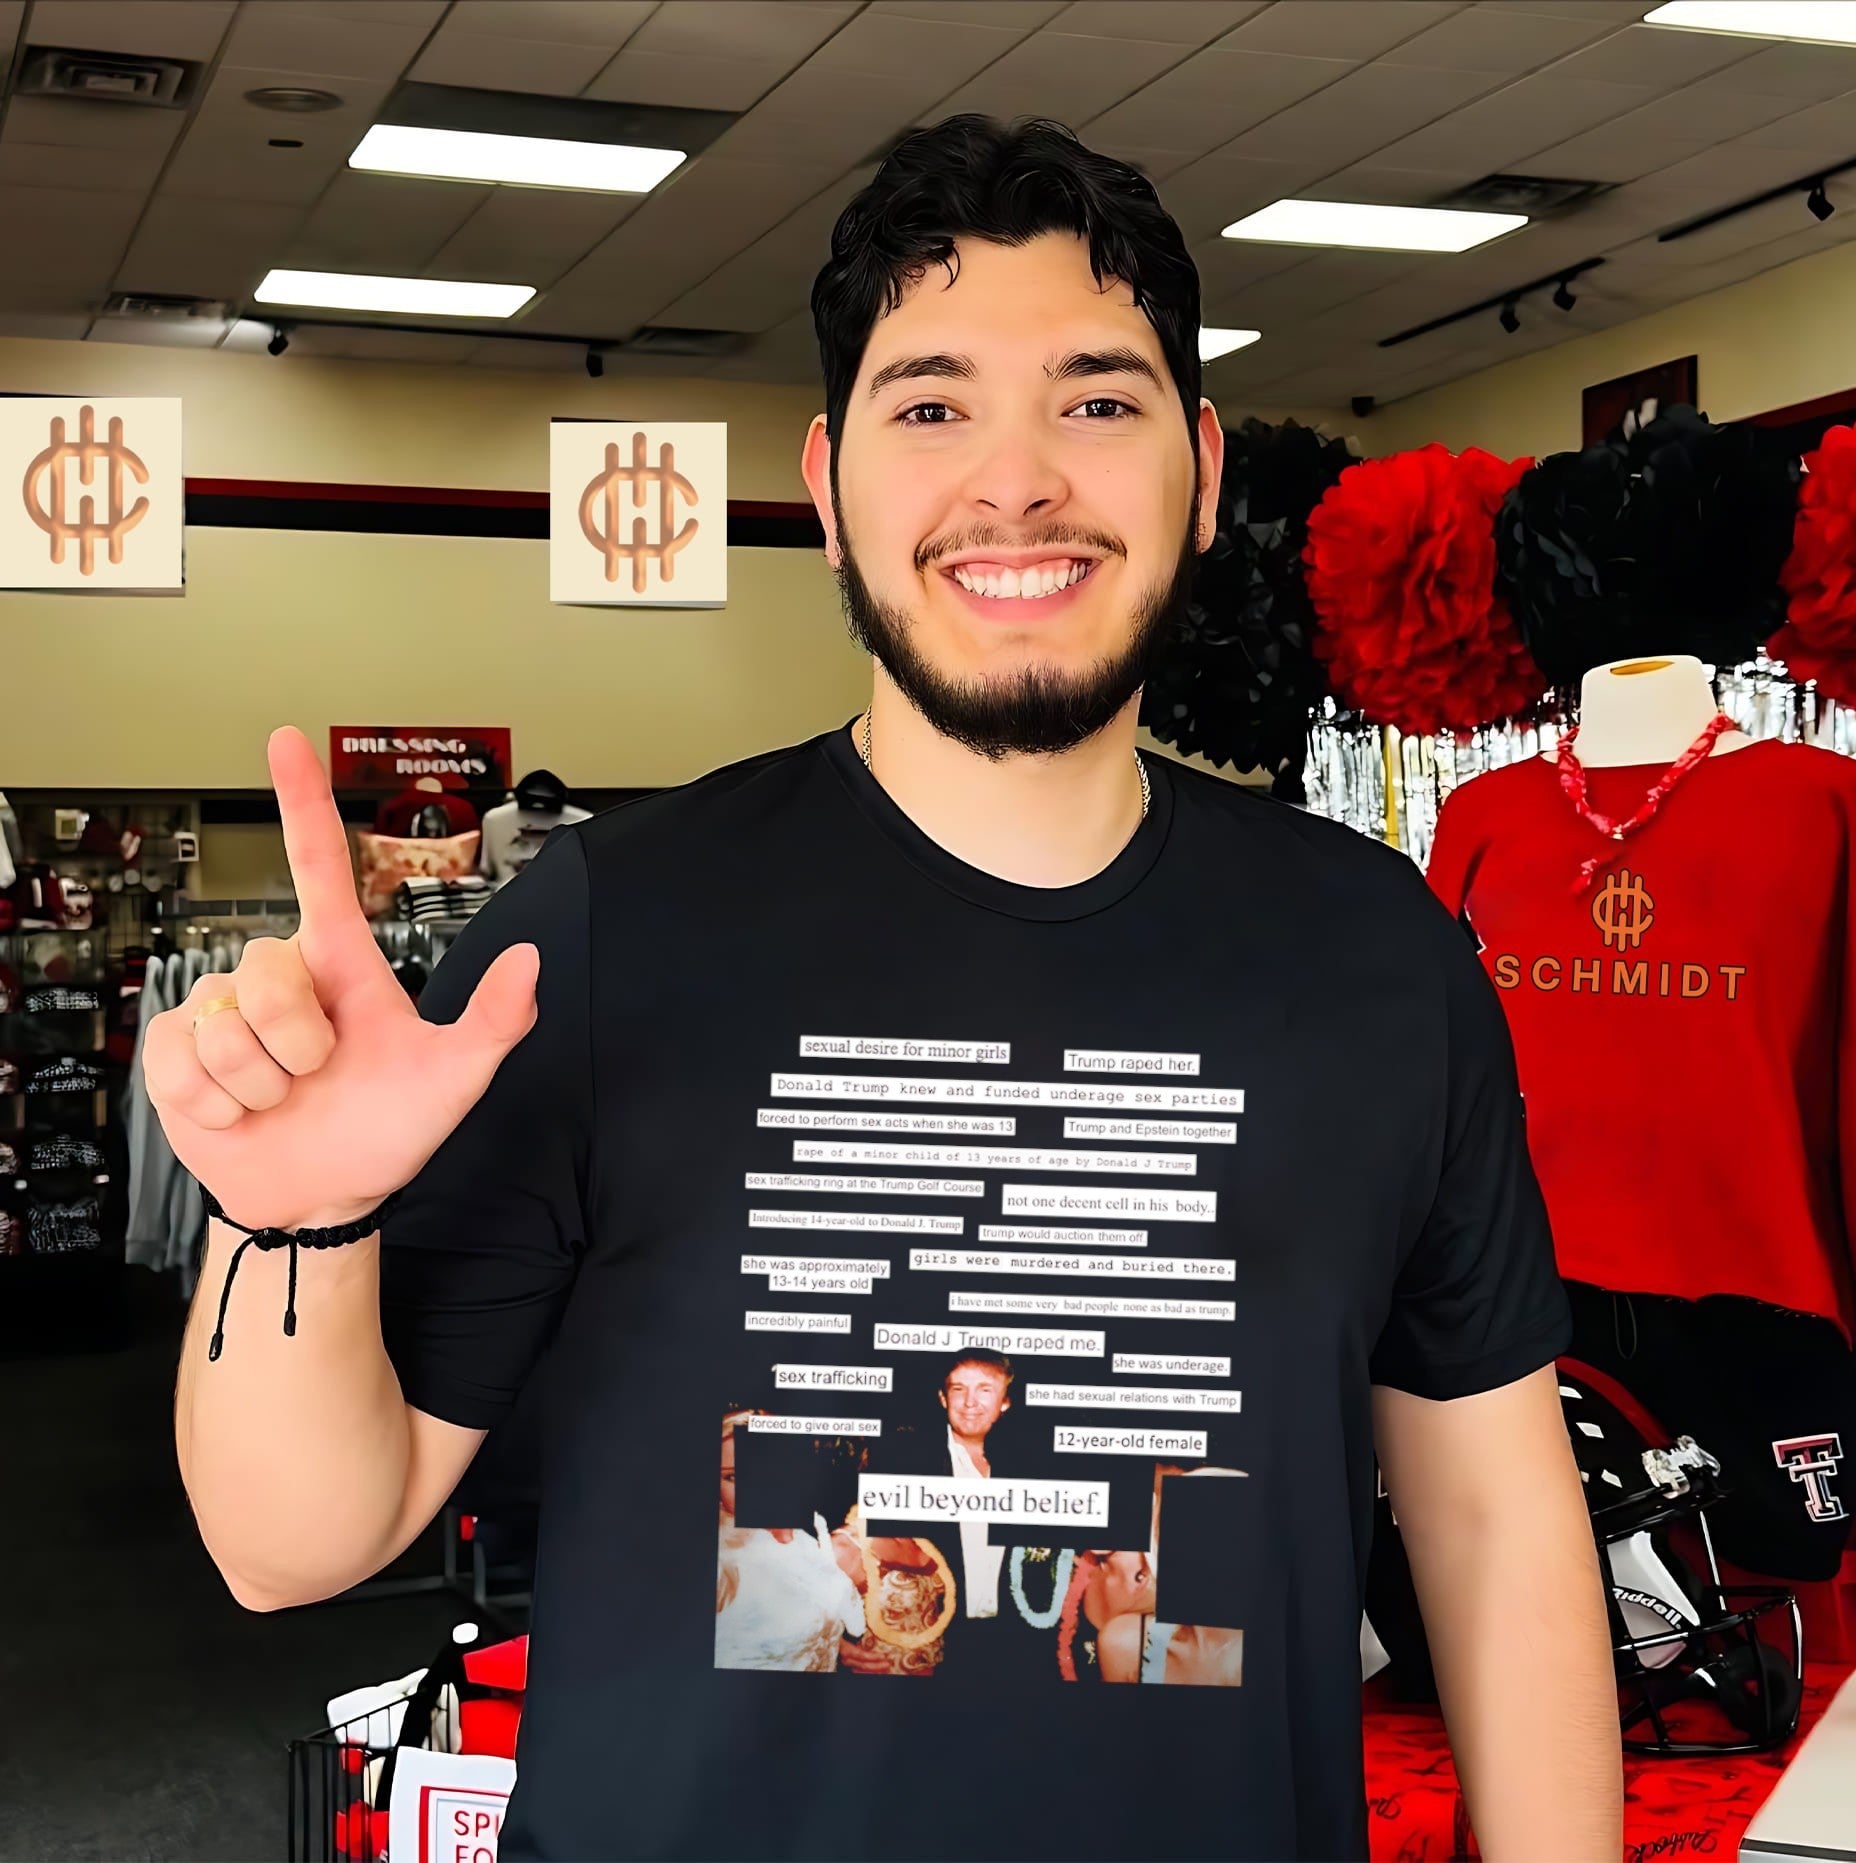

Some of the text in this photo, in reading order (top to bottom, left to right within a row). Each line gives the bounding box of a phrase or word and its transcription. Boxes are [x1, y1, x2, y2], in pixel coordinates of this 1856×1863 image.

[396, 758, 487, 775] ROOMS
[1494, 953, 1746, 1000] SCHMIDT
[804, 1038, 1006, 1062] sexual desire for minor girls
[1068, 1052, 1195, 1073] Trump raped her.
[777, 1077, 1236, 1108] Donald Trump knew and funded underage sex parties
[759, 1110, 1014, 1132] forced to perform sex acts when she was 13
[1068, 1119, 1231, 1140] Trump and Epstein together
[795, 1146, 1192, 1172] rape of a minor child of 13 years of age by Donald J Trump
[746, 1174, 981, 1194] sex trafficking ring at the Trump Golf Course
[1006, 1195, 1028, 1207] not
[1030, 1196, 1056, 1208] one
[1059, 1194, 1101, 1210] decent
[1103, 1196, 1129, 1211] cell
[1132, 1197, 1146, 1211] in
[1148, 1197, 1169, 1212] his
[752, 1211, 807, 1227] Introducing
[811, 1213, 865, 1228] 14-year-old
[867, 1217, 879, 1227] to
[880, 1216, 915, 1228] Donald
[928, 1217, 961, 1232] Trump
[982, 1226, 1015, 1240] trump
[1018, 1228, 1050, 1240] would
[1053, 1229, 1093, 1241] auction
[1097, 1230, 1127, 1243] them
[742, 1256, 887, 1277] she was approximately
[913, 1251, 1231, 1276] girls were murdered and buried there.
[772, 1275, 869, 1291] 13-14 years old
[956, 1294, 982, 1308] have
[983, 1297, 1004, 1308] met
[1005, 1299, 1034, 1309] some
[1034, 1300, 1058, 1312] very
[1062, 1298, 1083, 1311] bad
[1084, 1299, 1118, 1314] people
[1121, 1302, 1149, 1313] none
[1149, 1303, 1162, 1313] as
[1162, 1301, 1183, 1314] bad
[1183, 1305, 1197, 1314] as
[747, 1314, 847, 1330] incredibly painful
[877, 1327, 1102, 1353] Donald J Trump raped me.
[1113, 1355, 1227, 1374] she was underage.
[777, 1369, 887, 1390] sex trafficking
[1027, 1387, 1236, 1409] she had sexual relations with Trump
[750, 1417, 879, 1434] forced to give oral sex
[1058, 1431, 1202, 1451] 12-year-old female
[861, 1484, 1100, 1517] evil beyond belief.
